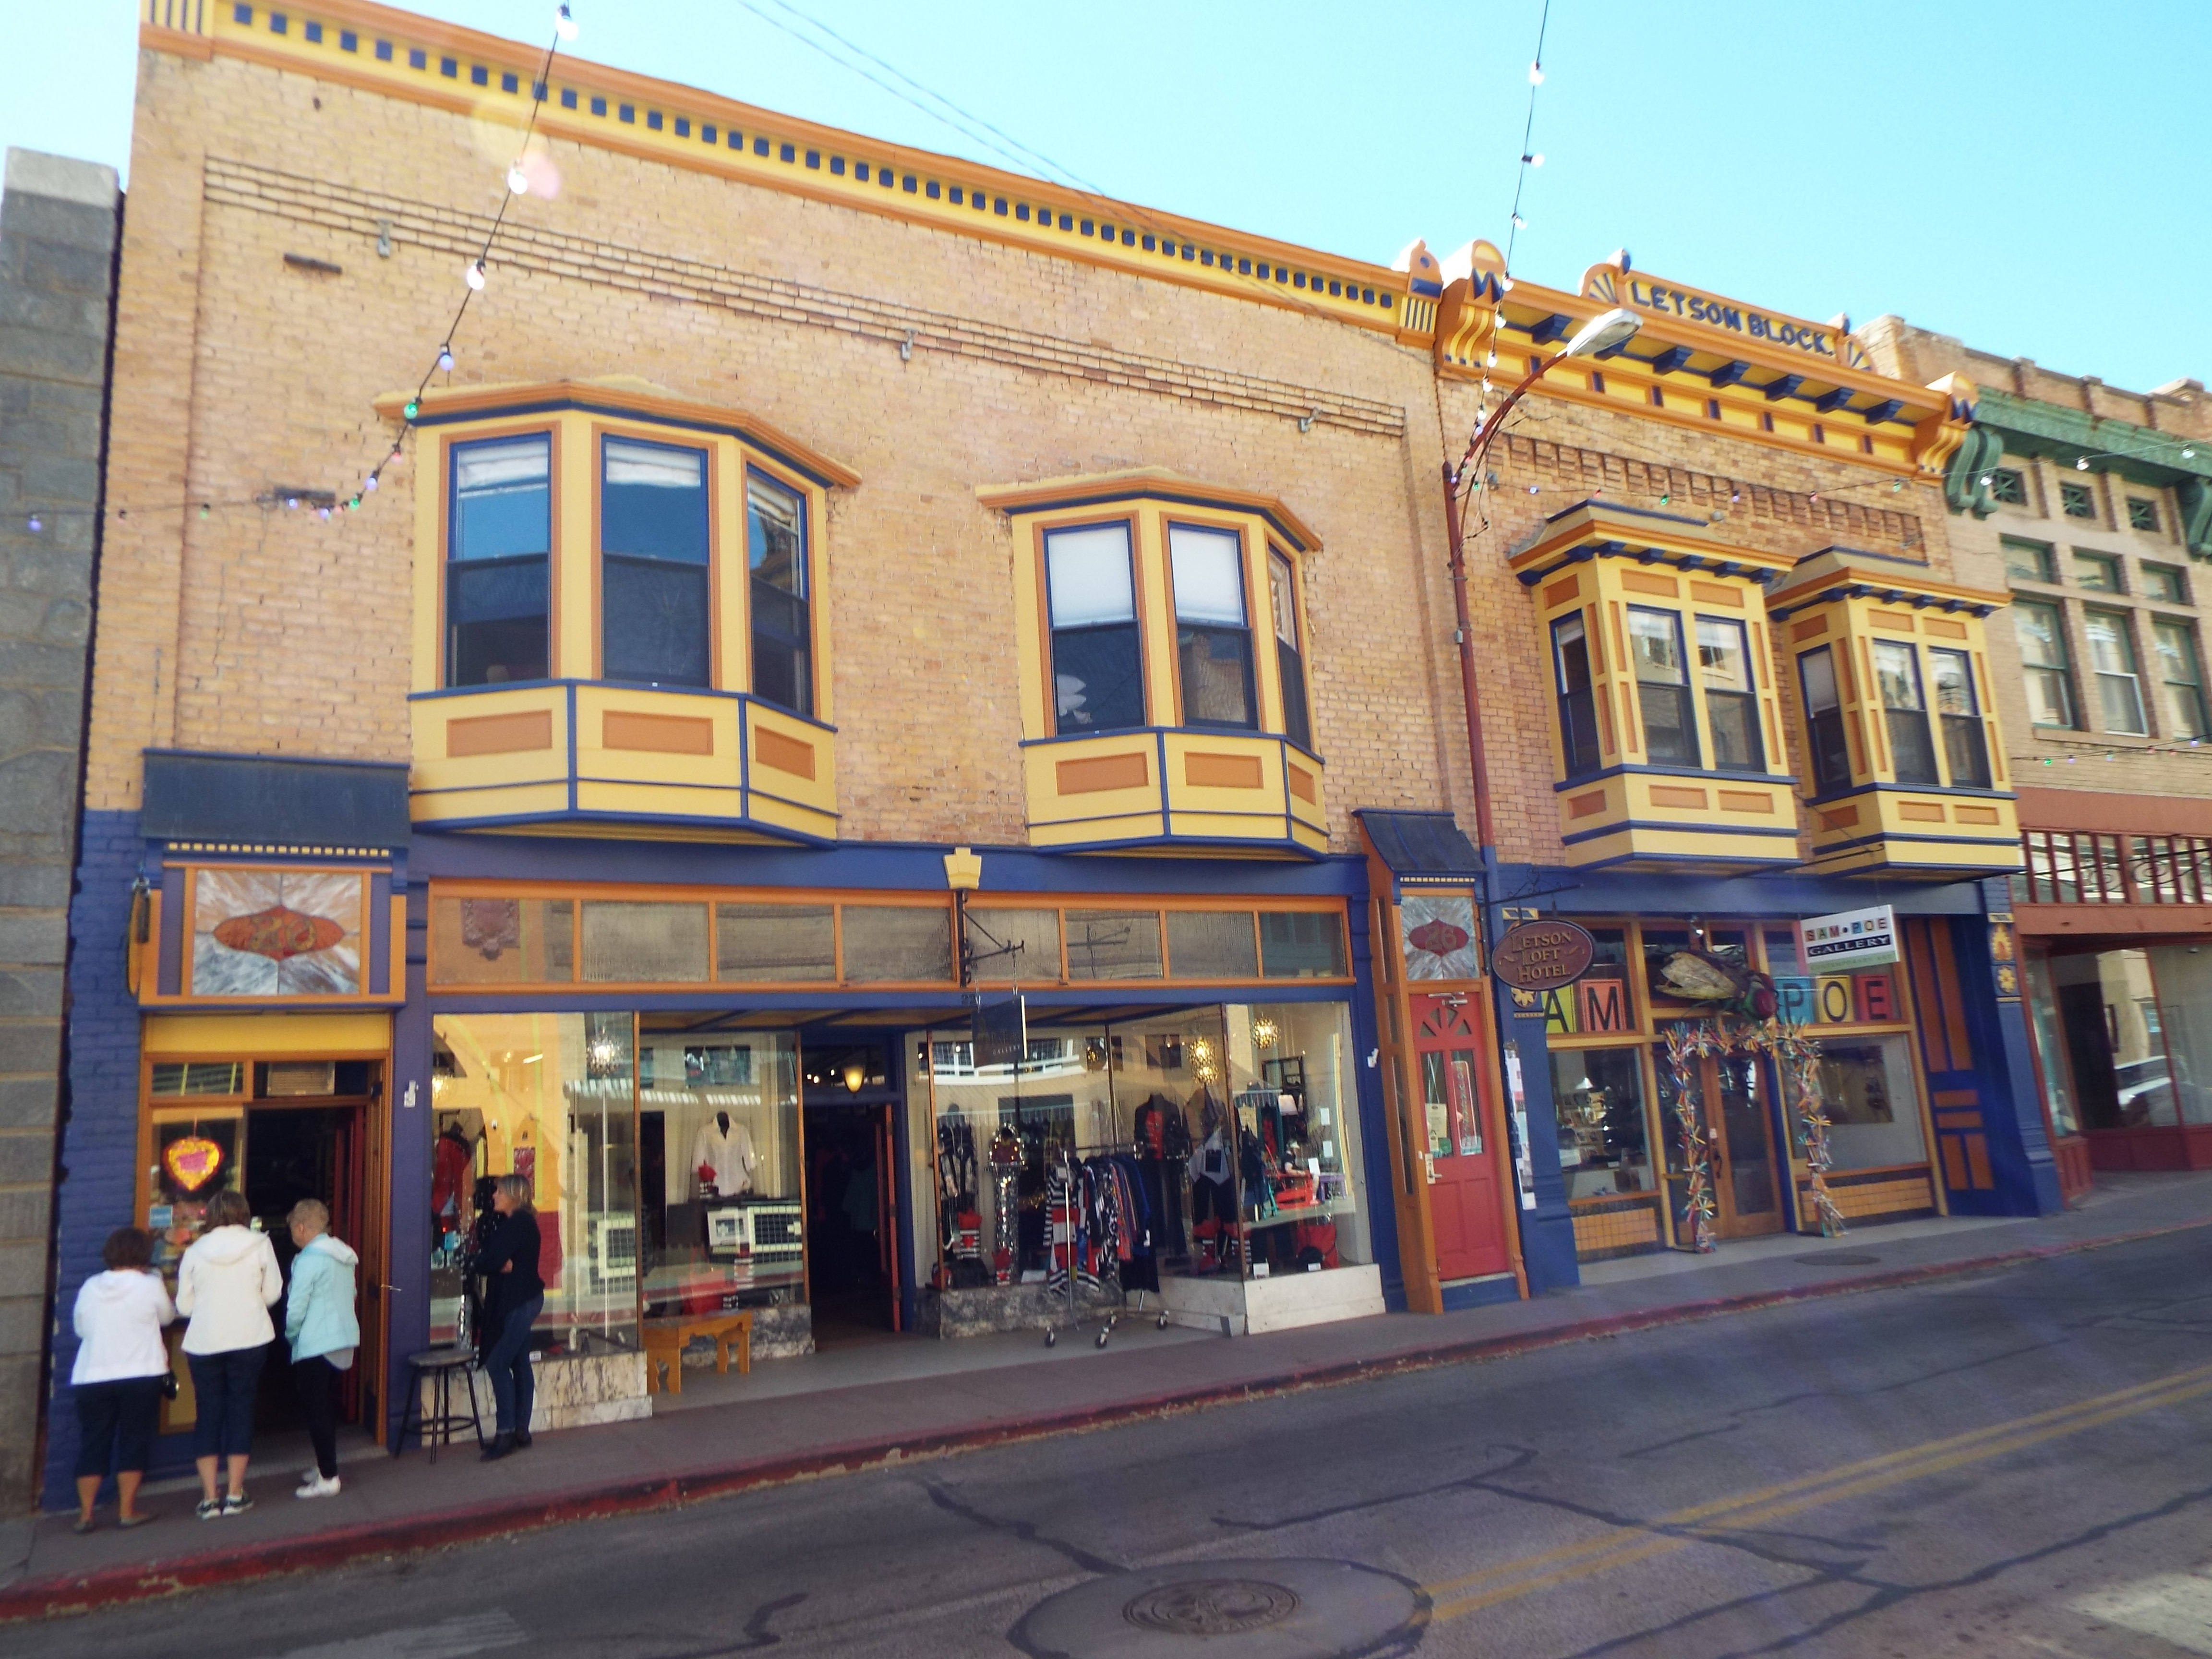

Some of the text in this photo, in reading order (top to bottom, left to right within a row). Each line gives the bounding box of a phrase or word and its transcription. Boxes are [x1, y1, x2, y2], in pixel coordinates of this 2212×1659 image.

[1631, 281, 1742, 332] LETSON
[1424, 925, 1457, 952] 26
[1805, 917, 1887, 942] SAM POE
[1809, 936, 1889, 955] GALLERY
[1783, 981, 1887, 1024] POE
[992, 1044, 1021, 1056] GALLERY
